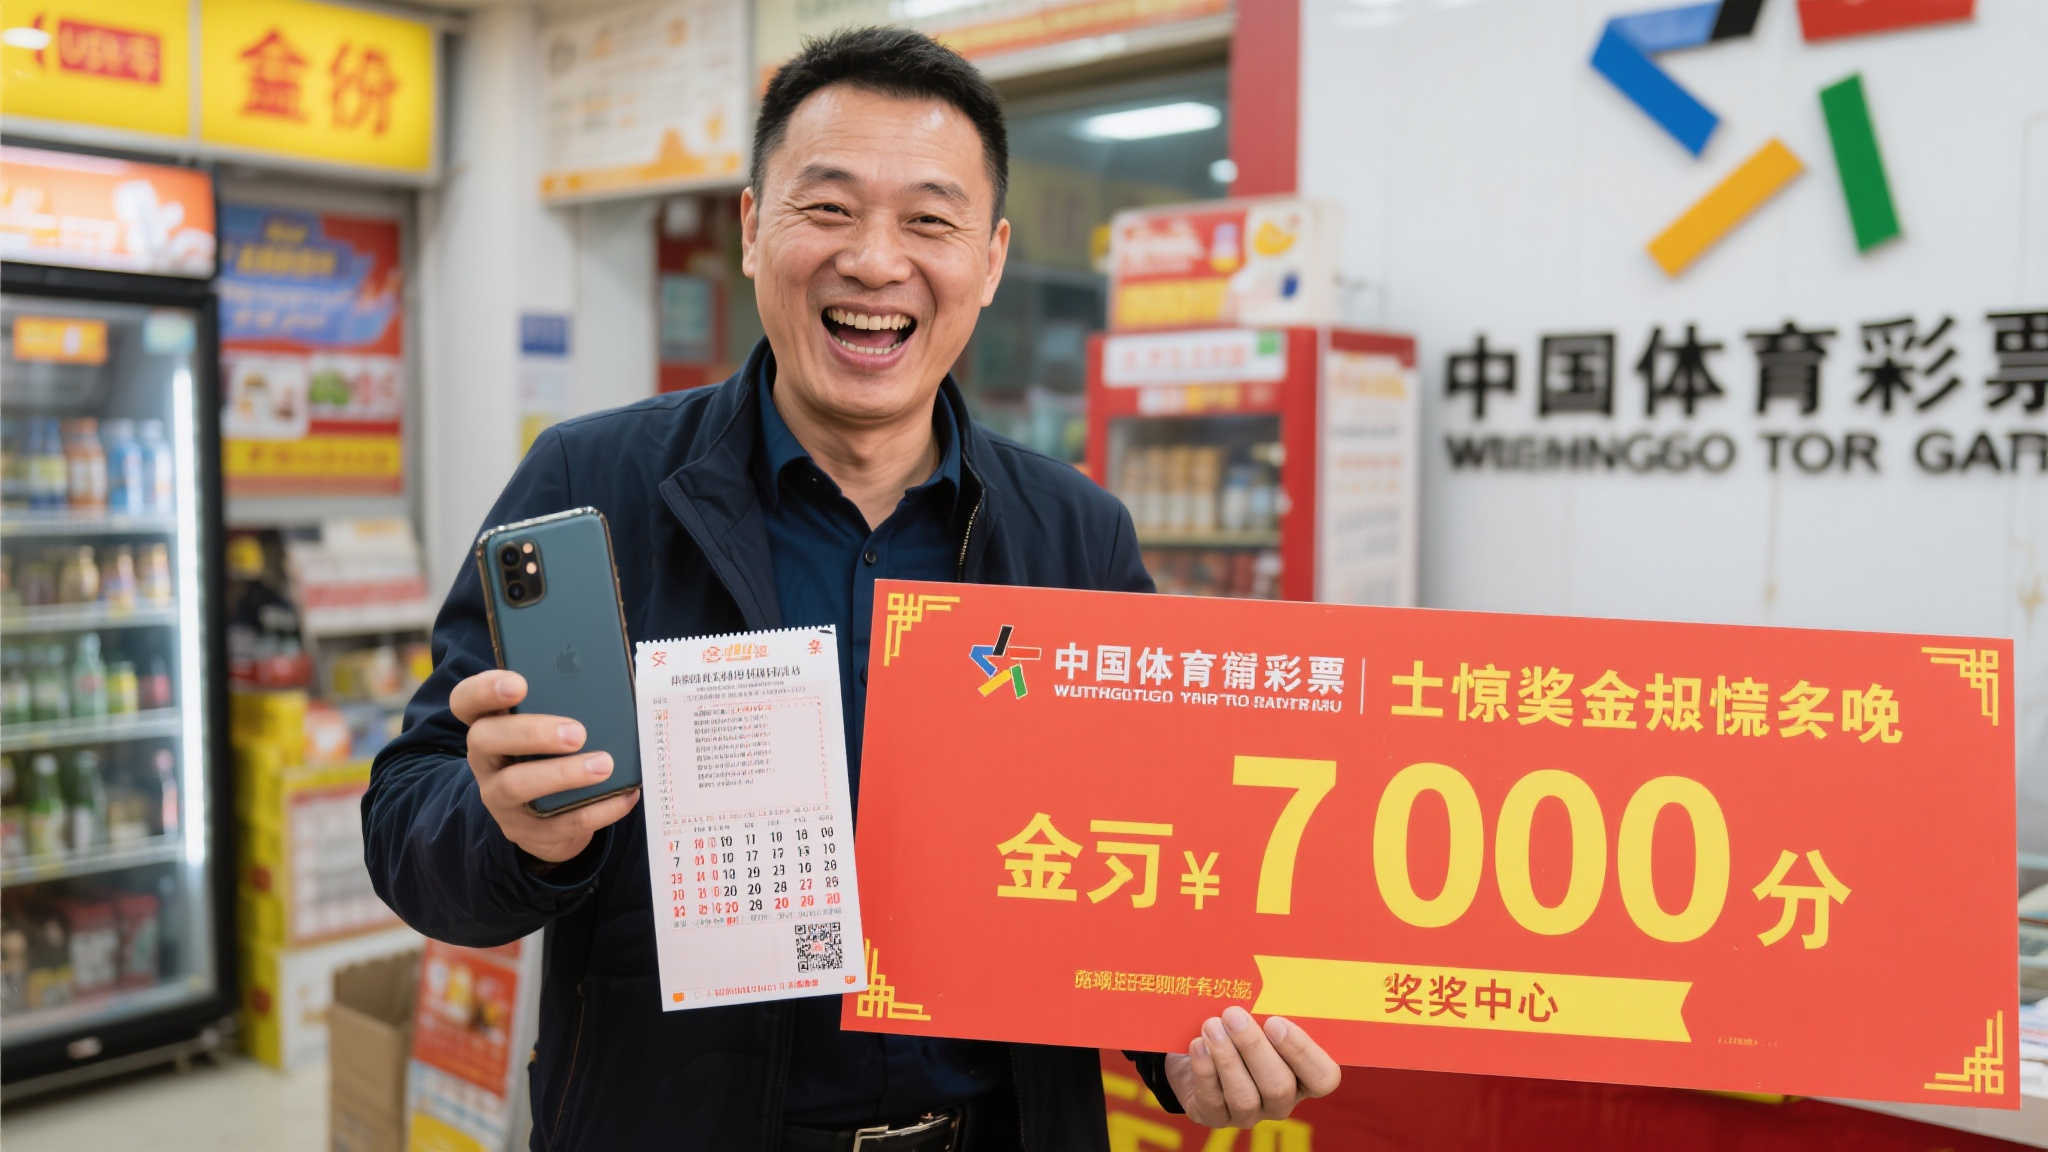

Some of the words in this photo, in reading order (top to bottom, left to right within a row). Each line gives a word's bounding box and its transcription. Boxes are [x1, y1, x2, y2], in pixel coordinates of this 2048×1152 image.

[1444, 311, 2048, 418] 中国体育彩票
